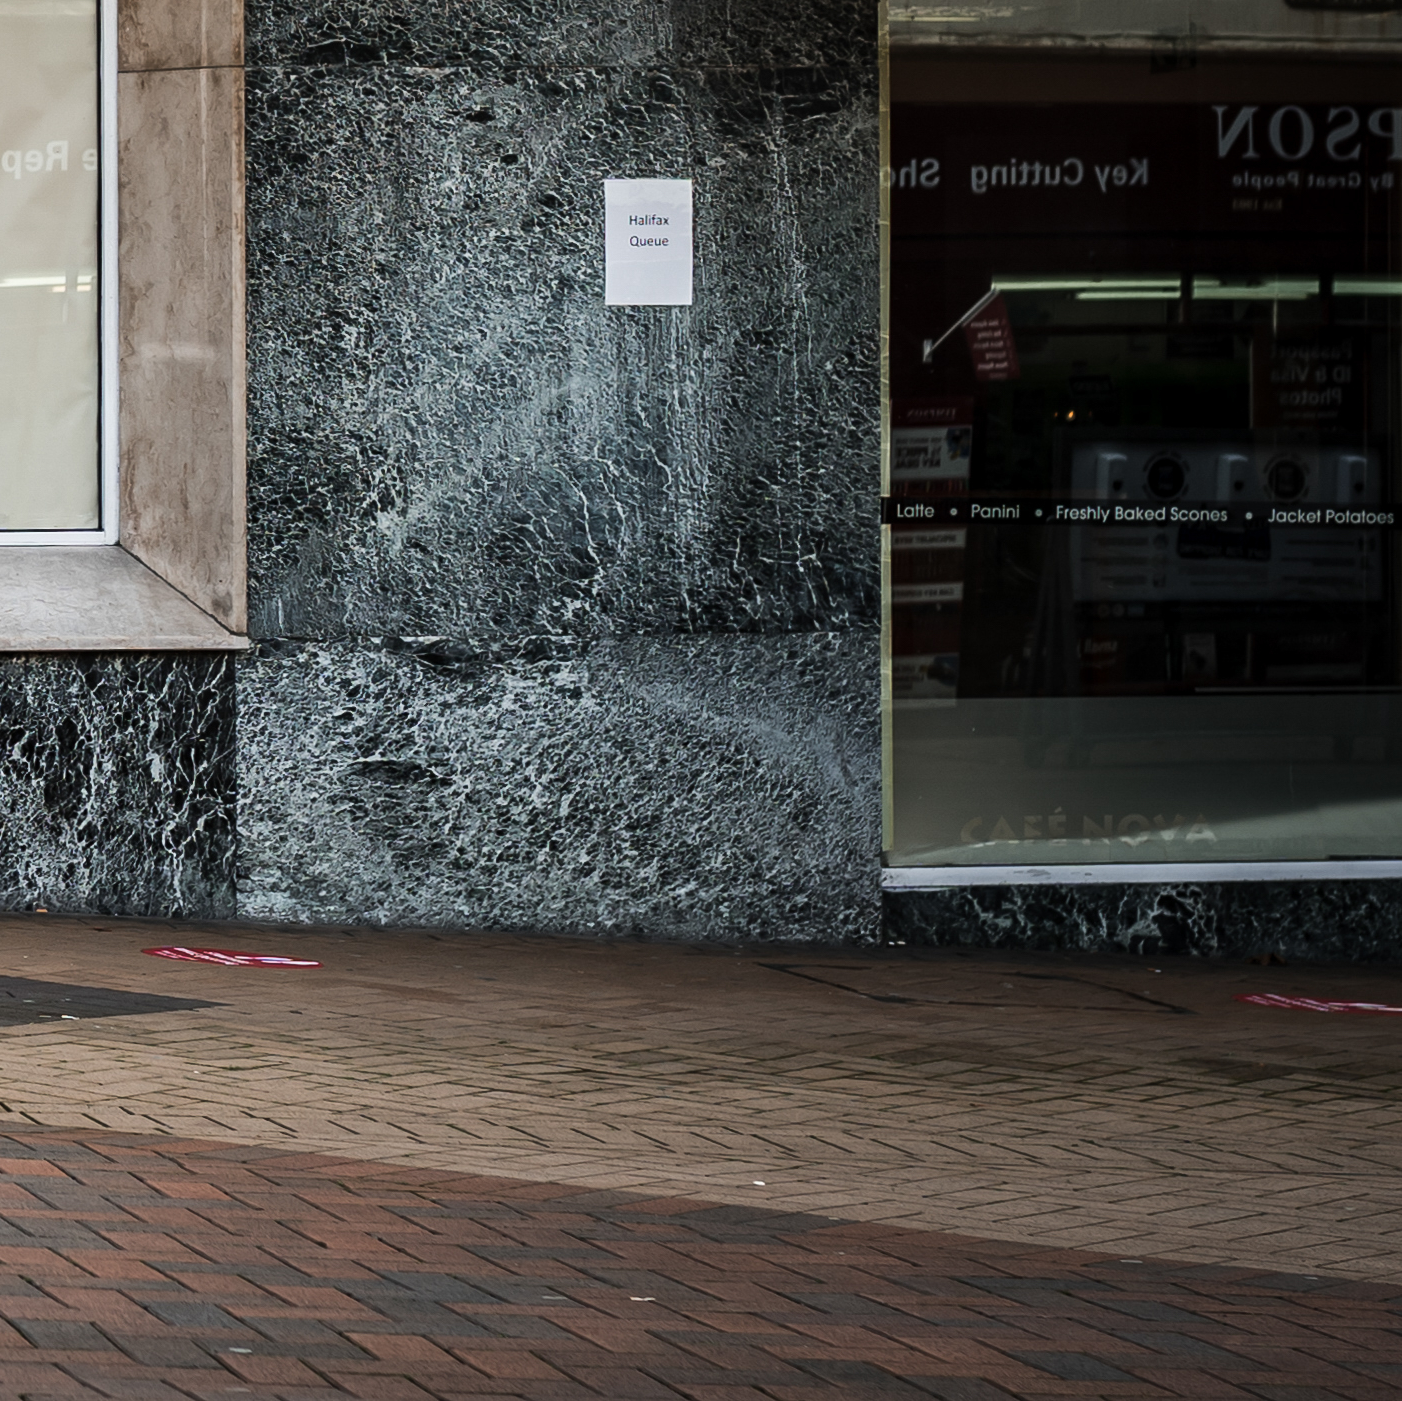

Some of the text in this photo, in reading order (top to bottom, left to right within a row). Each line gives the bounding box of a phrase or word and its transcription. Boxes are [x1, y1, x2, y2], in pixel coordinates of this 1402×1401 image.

[629, 214, 670, 226] Halifax
[629, 235, 670, 248] Queue
[896, 503, 1395, 525] Latte Panini Freshly Baked Scones Jacket Potatoes
